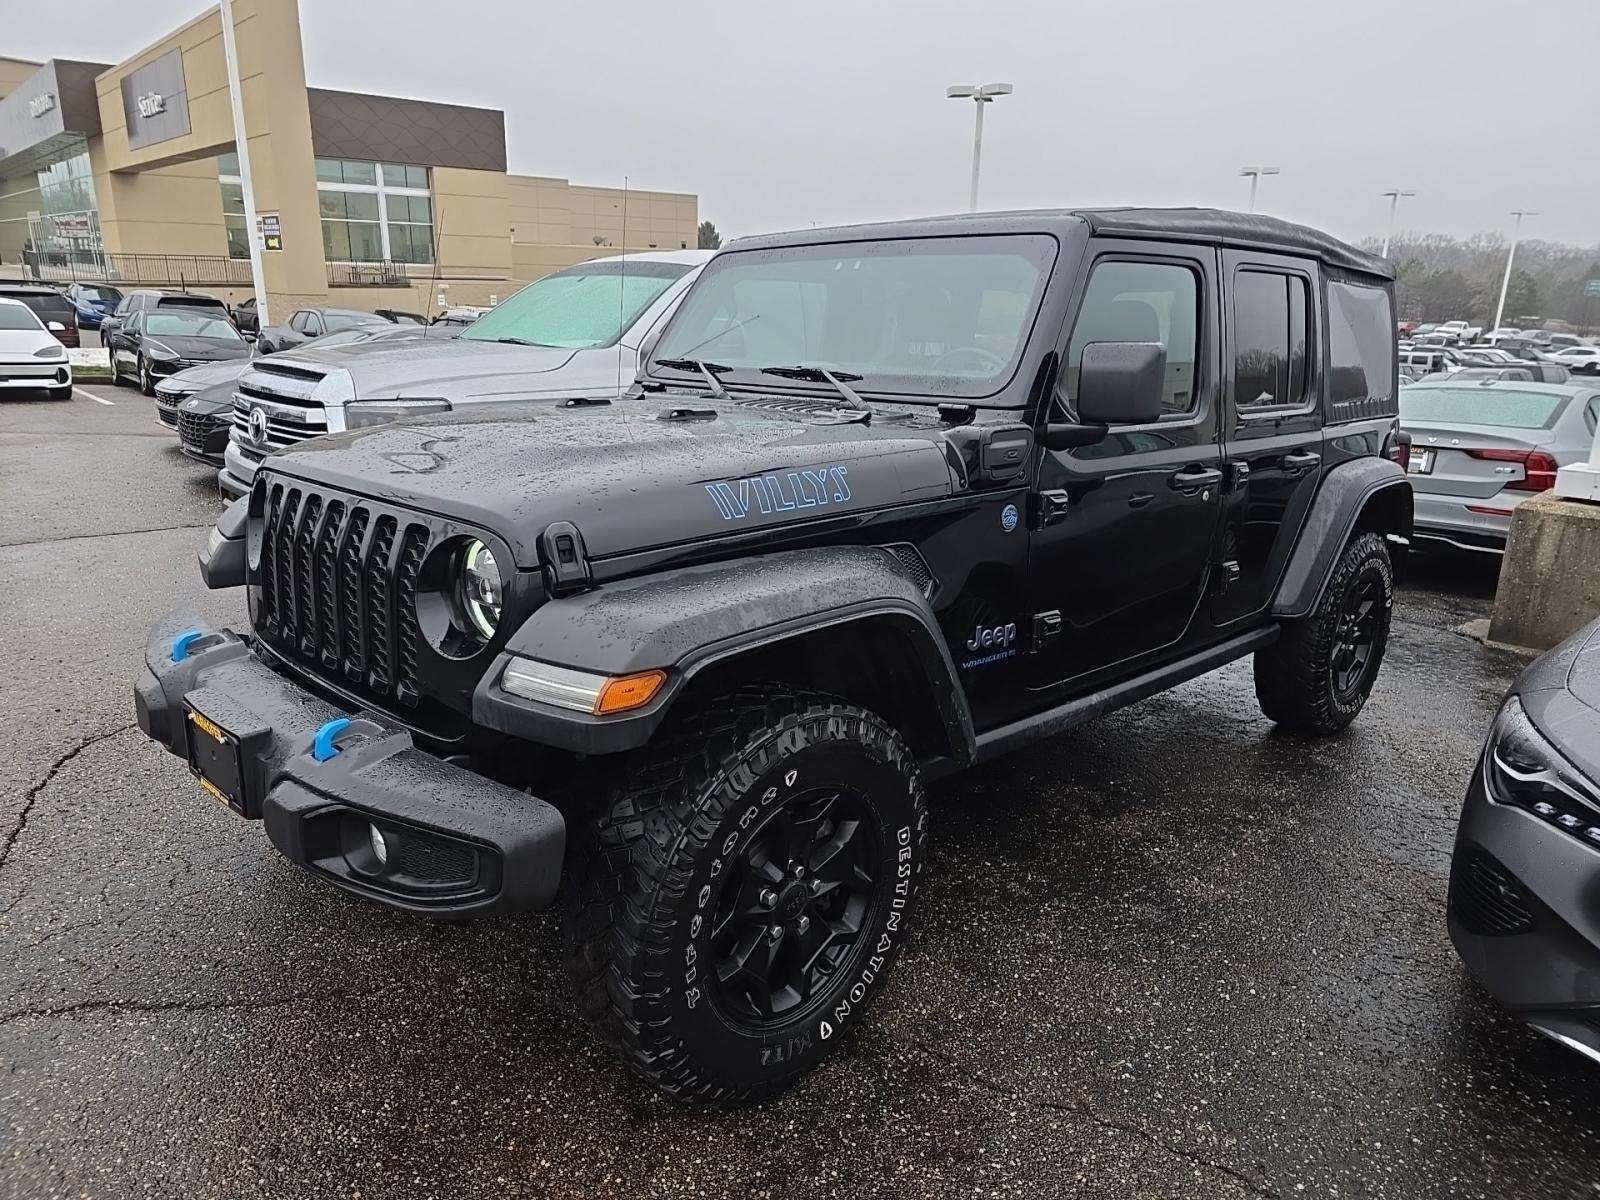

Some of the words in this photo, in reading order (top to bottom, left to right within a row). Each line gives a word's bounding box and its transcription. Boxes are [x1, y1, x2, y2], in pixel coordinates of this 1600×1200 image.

[704, 465, 852, 520] WILLYS
[966, 622, 1017, 651] Jeep
[834, 826, 912, 1024] DESTINATION
